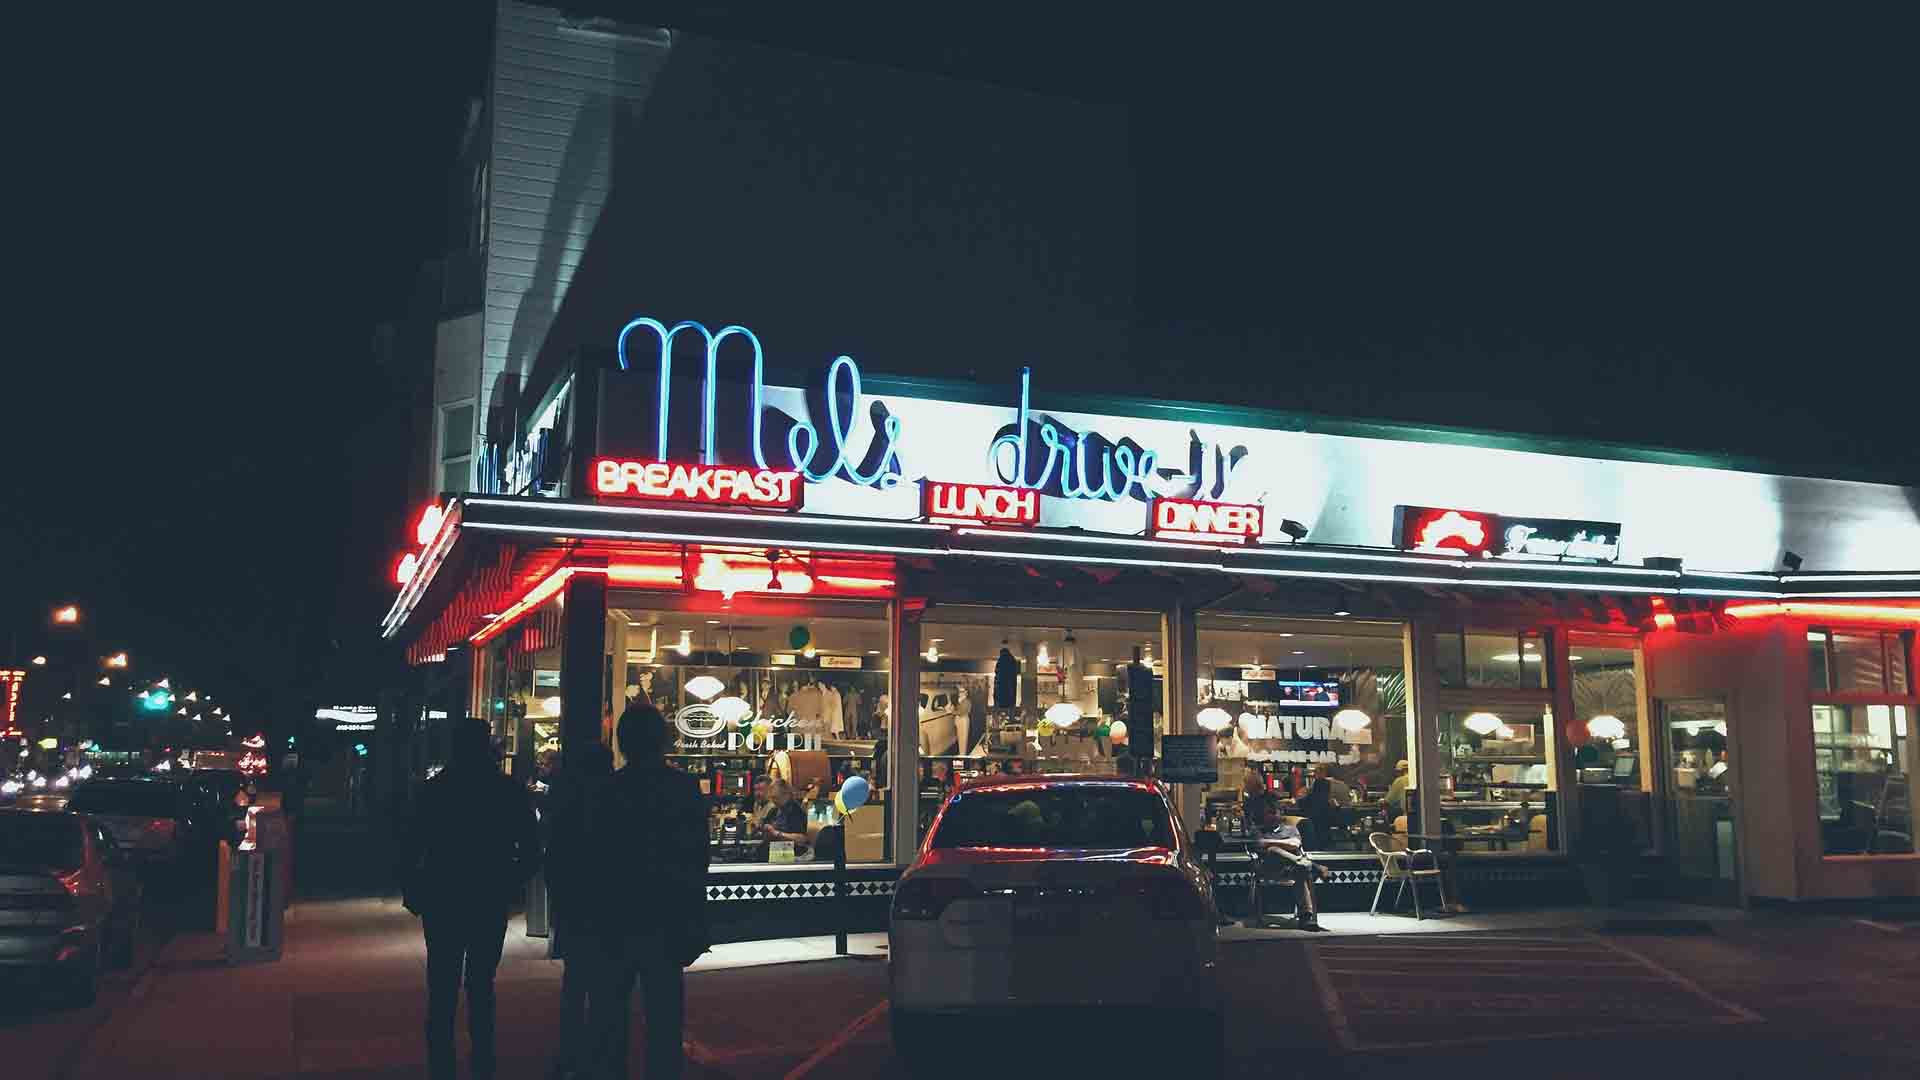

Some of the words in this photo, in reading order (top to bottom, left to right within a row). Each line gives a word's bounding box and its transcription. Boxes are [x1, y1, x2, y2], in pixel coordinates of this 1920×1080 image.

[617, 317, 904, 490] Mels
[597, 460, 800, 502] BREAKFAST
[934, 484, 1035, 520] LUNCH
[1158, 501, 1260, 535] DINNER
[727, 732, 777, 751] POT
[1247, 715, 1358, 740] NATURA
